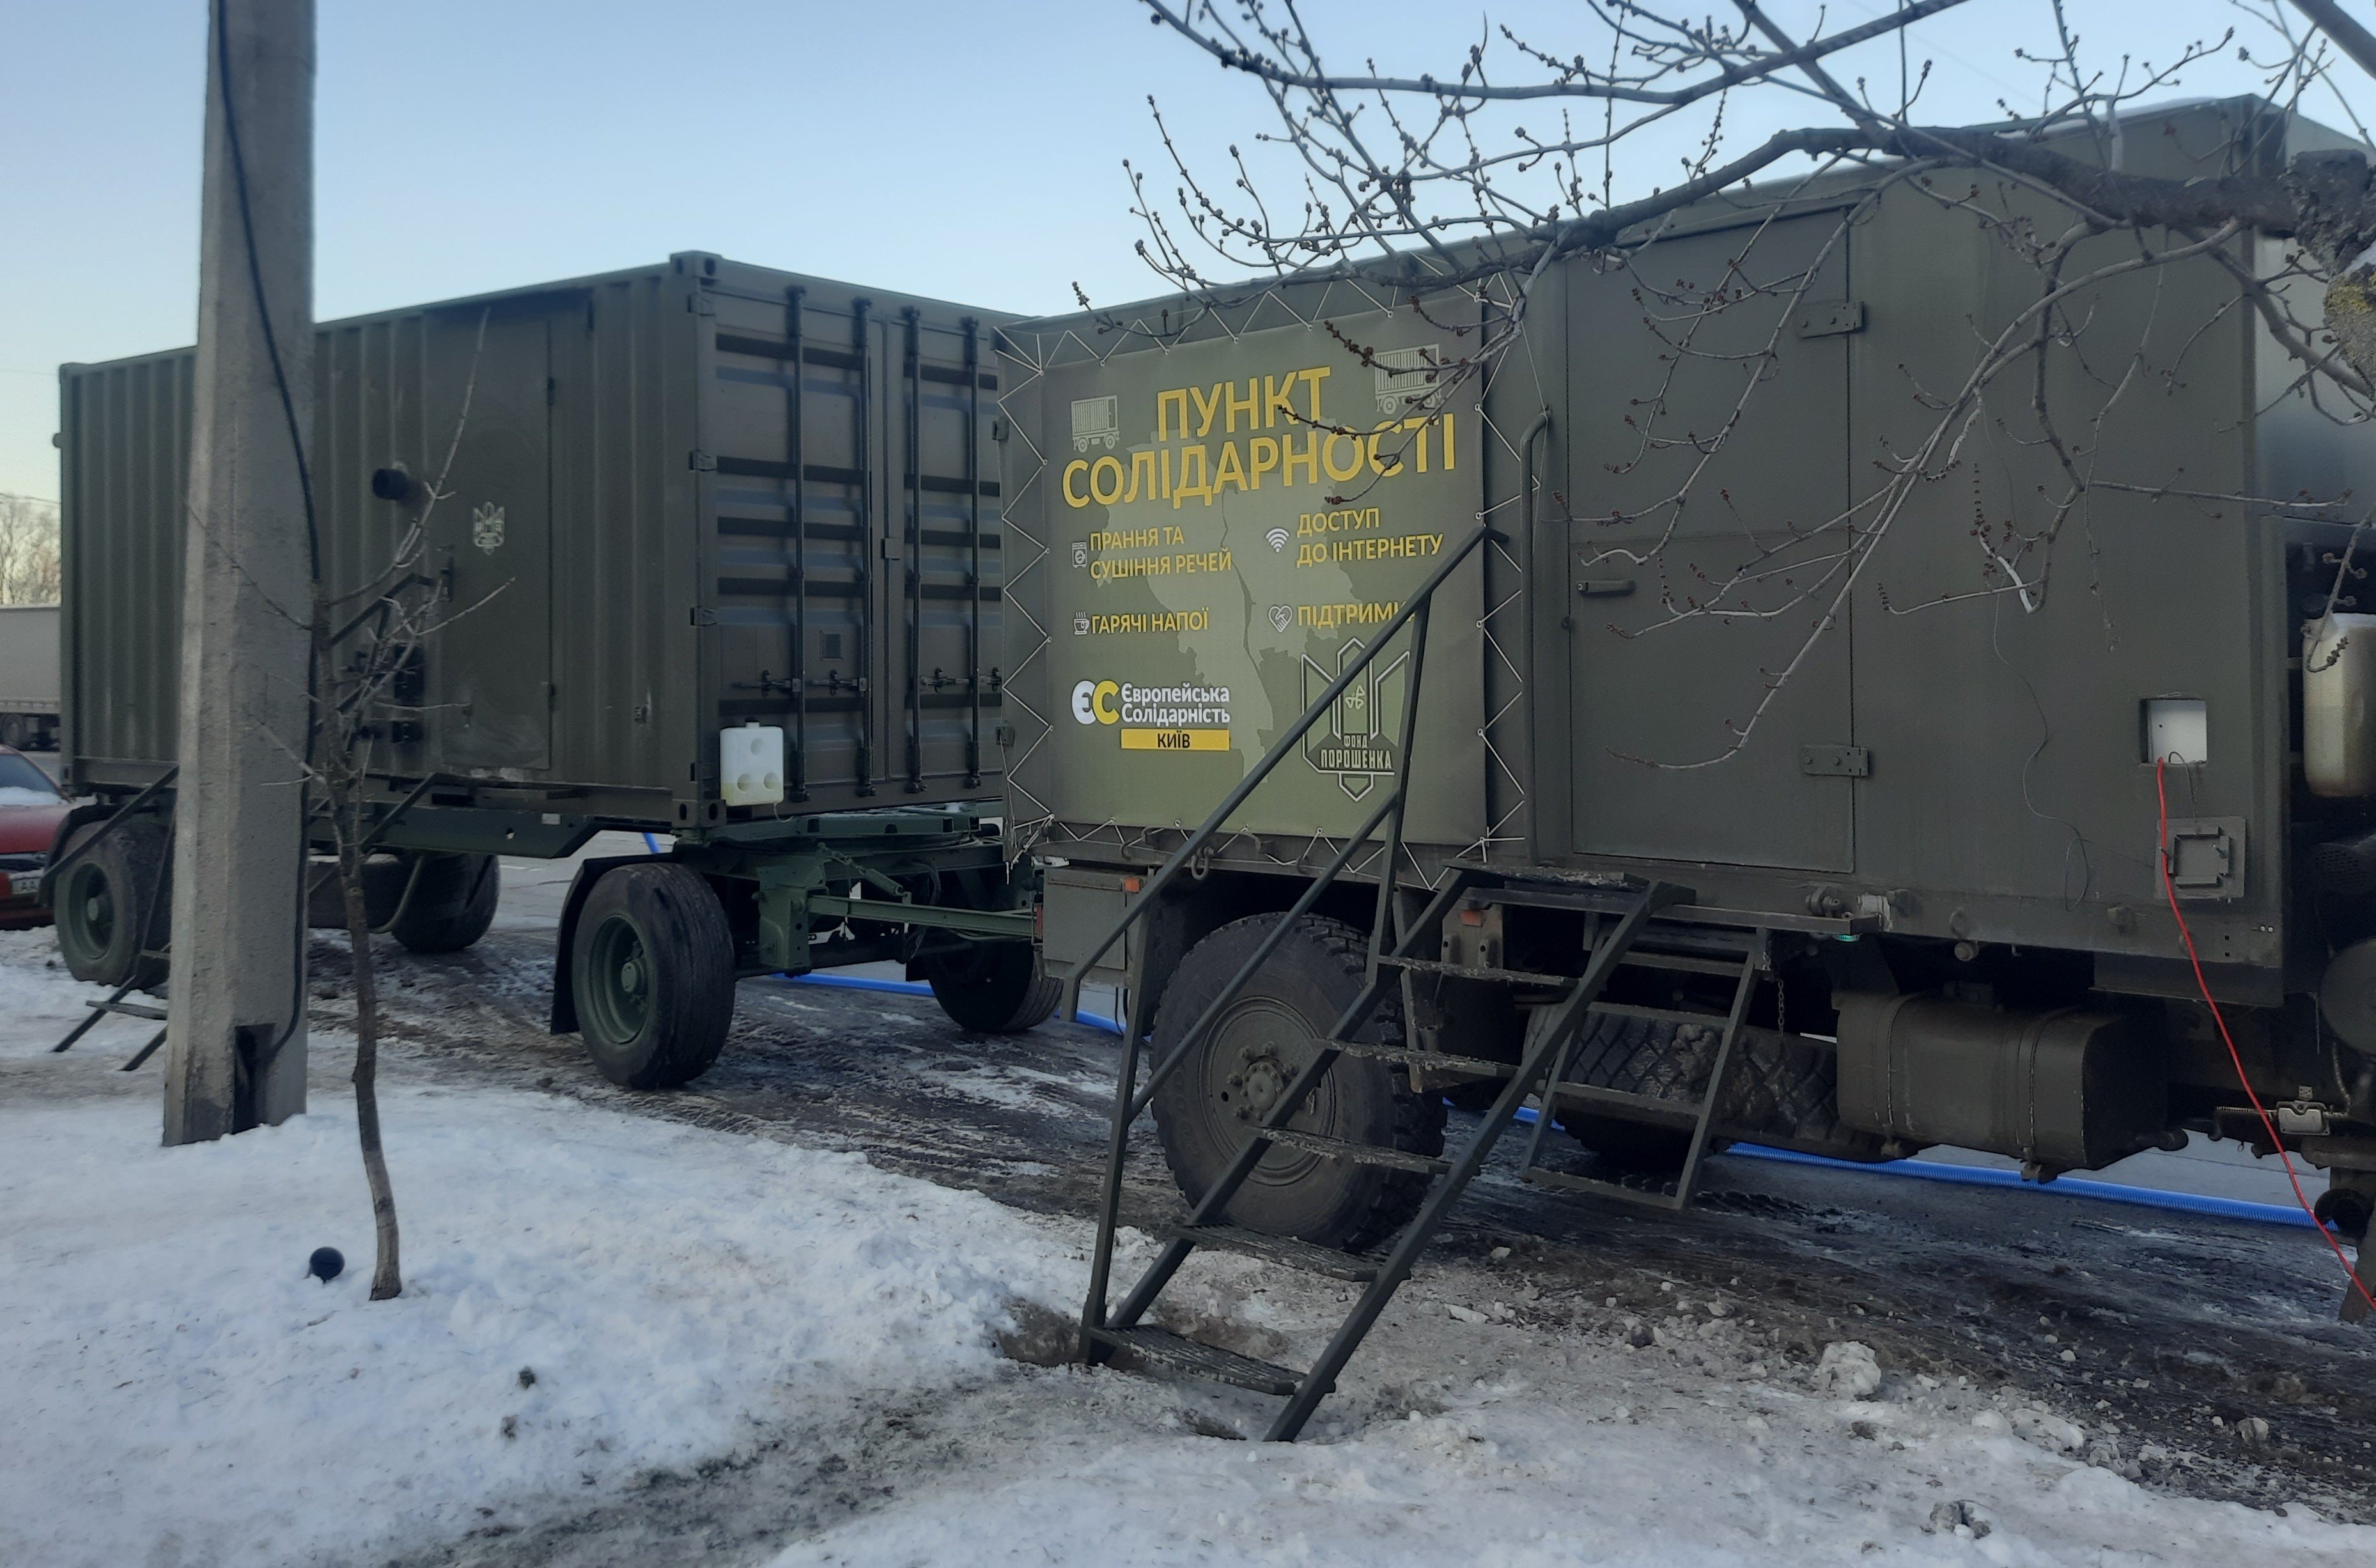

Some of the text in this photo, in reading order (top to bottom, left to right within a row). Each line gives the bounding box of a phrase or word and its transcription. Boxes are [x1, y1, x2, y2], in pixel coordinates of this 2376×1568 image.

[1157, 366, 1331, 442] ПУНКТ
[1062, 413, 1456, 509] СОЛІДАРНОСТІ
[1296, 508, 1380, 538] ДОСТУП
[1090, 526, 1185, 551] ПРАННЯ ТА
[1296, 534, 1443, 568] ДО ІНТЕРНЕТУ
[1090, 547, 1232, 579] СУШІННЯ РЕЧЕЙ
[1092, 607, 1209, 634] ГАРЯЧІ НАПОЇ
[1298, 601, 1416, 629] ПІДТРИМ
[1071, 679, 1120, 725] ЄС
[1121, 682, 1230, 706] Європейська
[1121, 703, 1231, 727] Солідарність
[1158, 730, 1190, 749] КИЇВ
[1344, 734, 1368, 749] ФОНД
[1321, 749, 1392, 769] ПОРОШЕНКА
